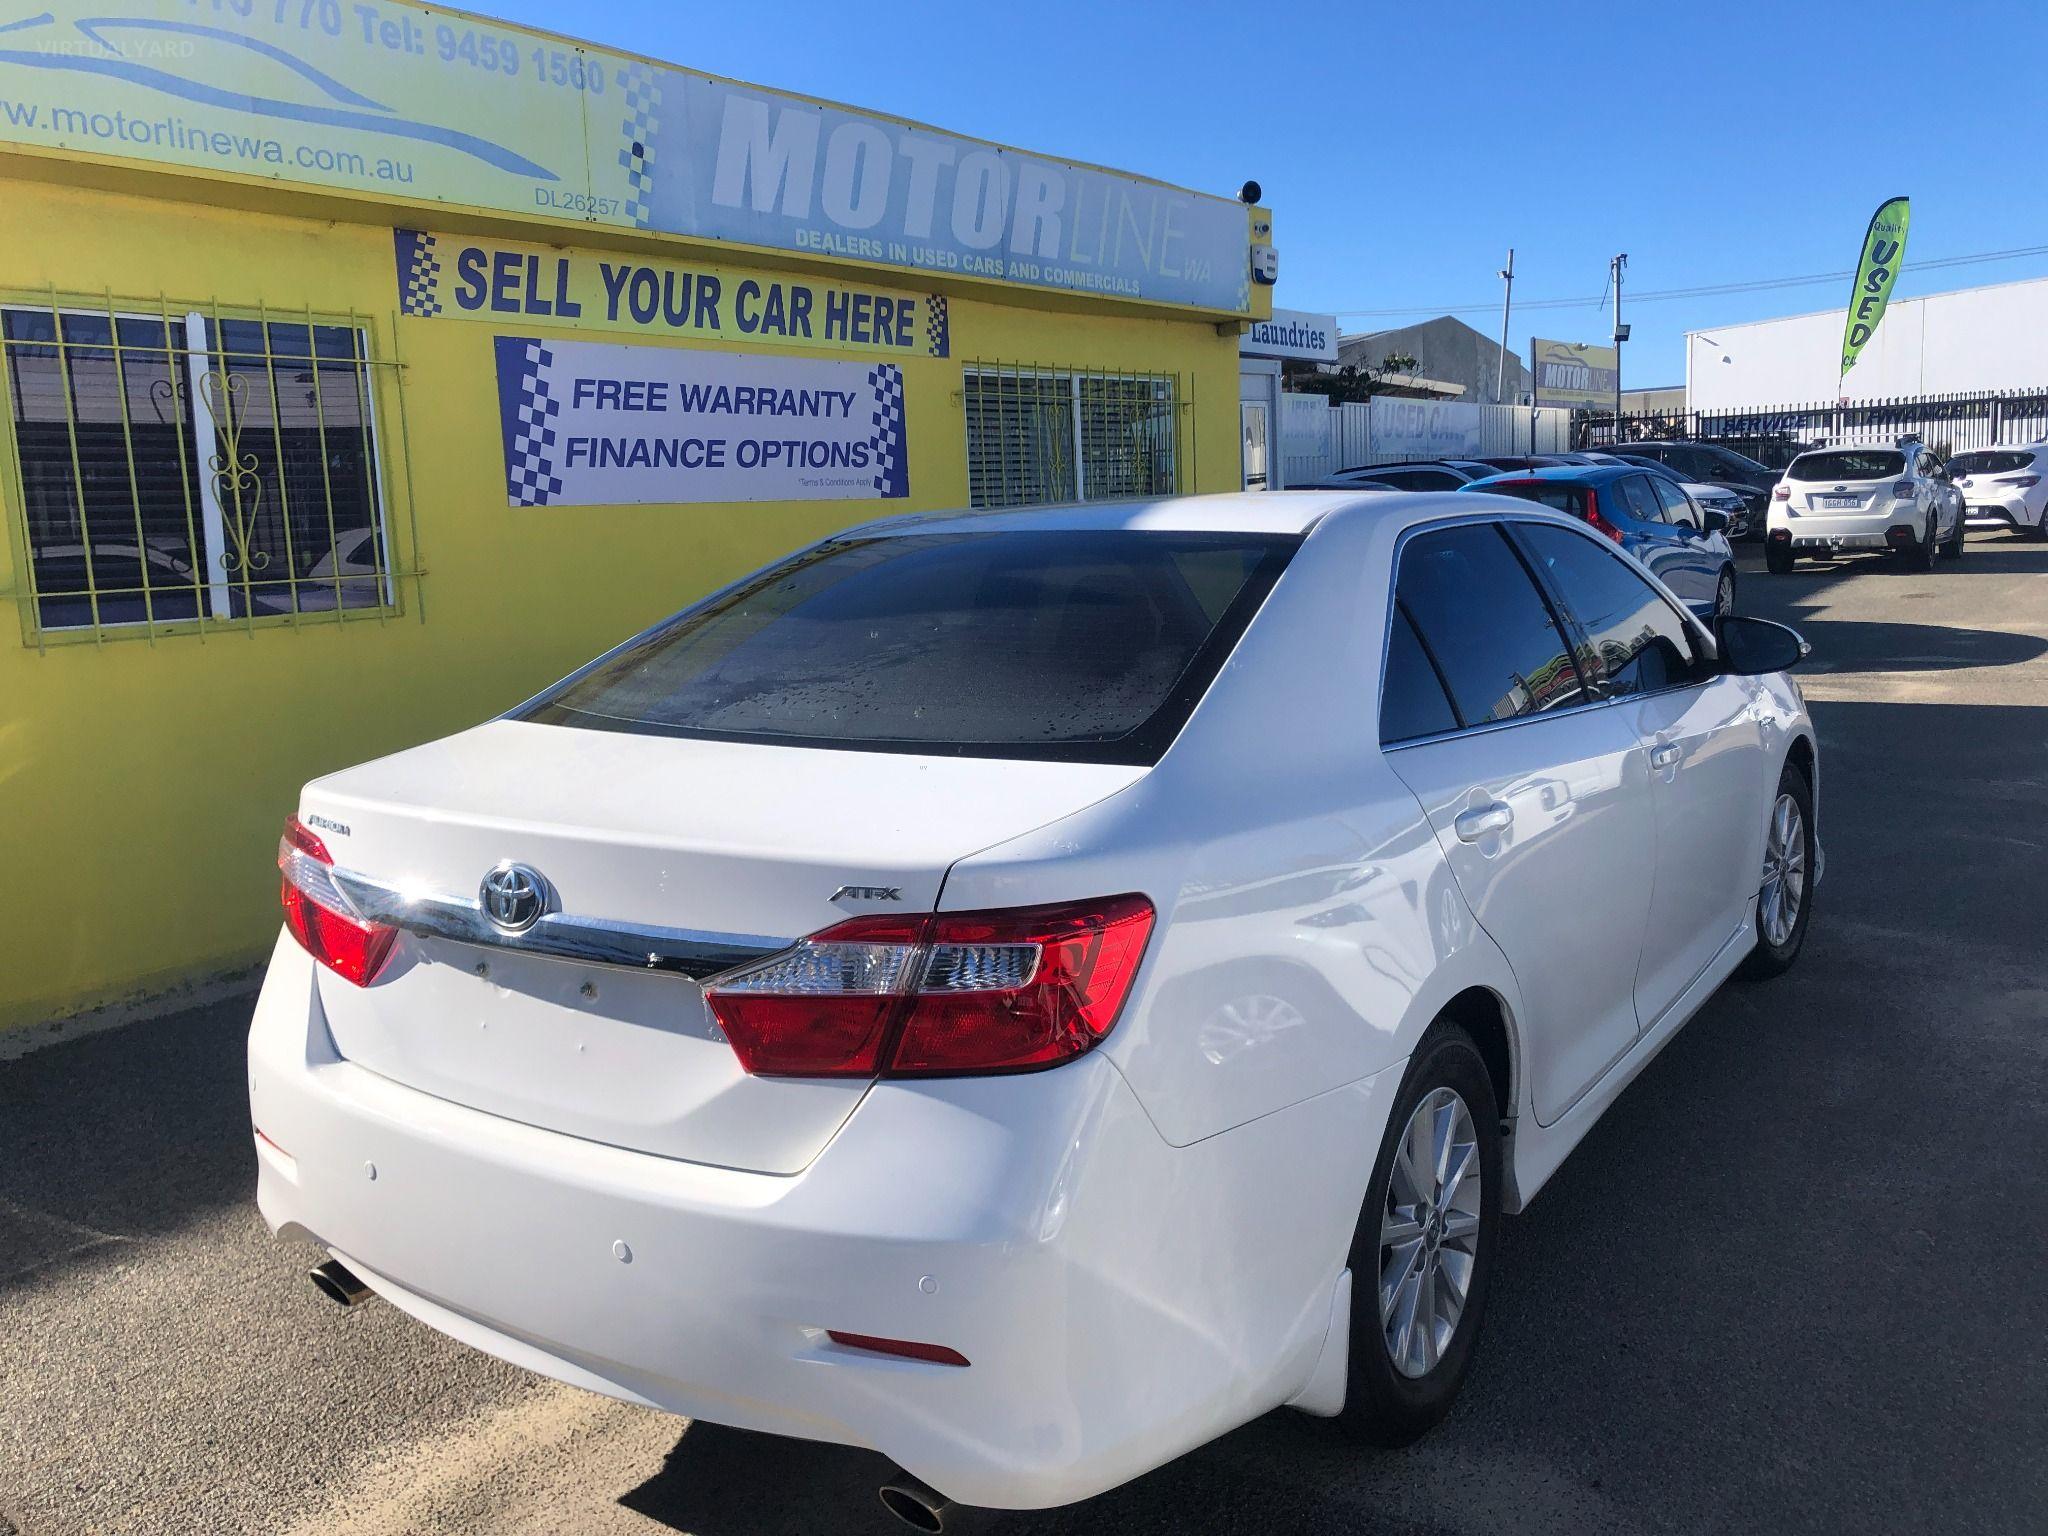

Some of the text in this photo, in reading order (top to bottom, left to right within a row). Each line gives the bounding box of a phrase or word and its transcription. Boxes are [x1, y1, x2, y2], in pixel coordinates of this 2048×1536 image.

[354, 5, 425, 55] Tel:
[435, 24, 520, 77] 9459
[531, 47, 605, 95] 1560
[0, 100, 413, 183] w.motorlinewa.com.au
[535, 187, 620, 217] DL26257
[795, 228, 1141, 295] DEALERS IN USED CARS AND COMMERCIALS
[455, 247, 915, 348] SELL YOUR CAR HERE
[1849, 239, 1900, 348] USED
[1251, 321, 1326, 351] Laundries
[572, 378, 857, 419] FREE WARRANTY
[1722, 413, 1807, 434] SERVICE
[565, 437, 870, 469] FINANCE OPTIONS
[856, 478, 872, 488] Apply
